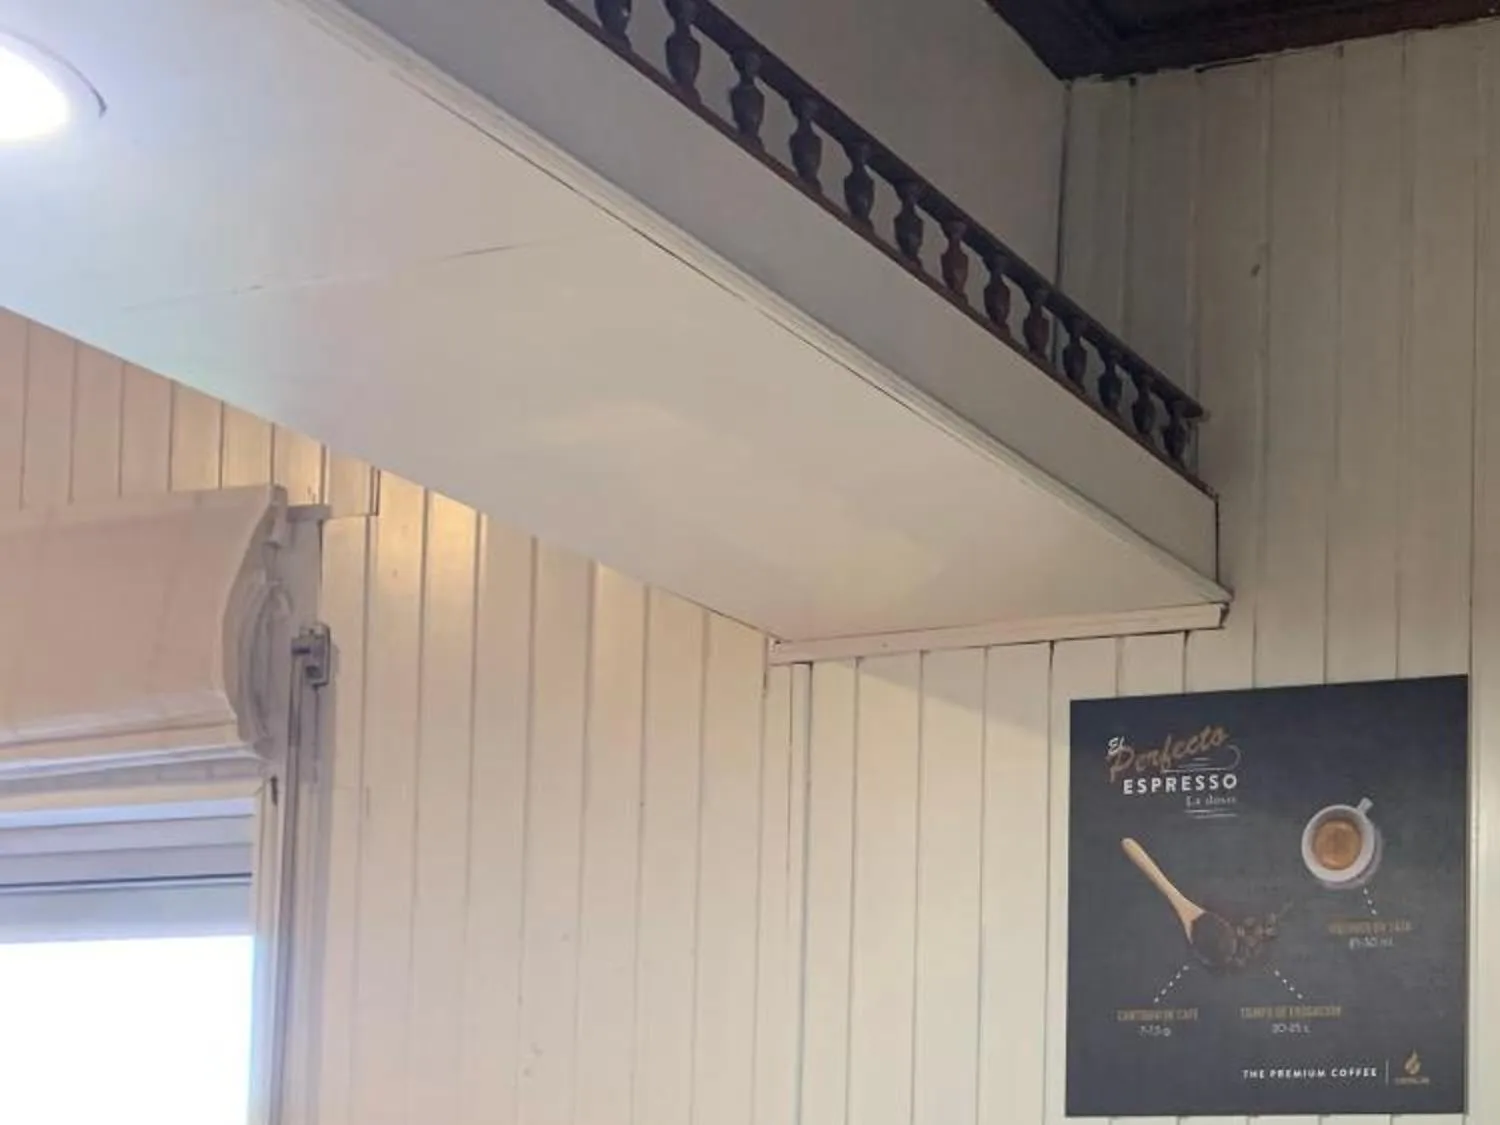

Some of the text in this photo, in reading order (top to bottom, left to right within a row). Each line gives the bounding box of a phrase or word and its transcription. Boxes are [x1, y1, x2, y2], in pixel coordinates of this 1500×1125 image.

[1105, 725, 1230, 784] Perfecto
[1122, 772, 1238, 797] ESPRESSO
[1242, 1066, 1378, 1081] THE PREMIUM COFFEE
